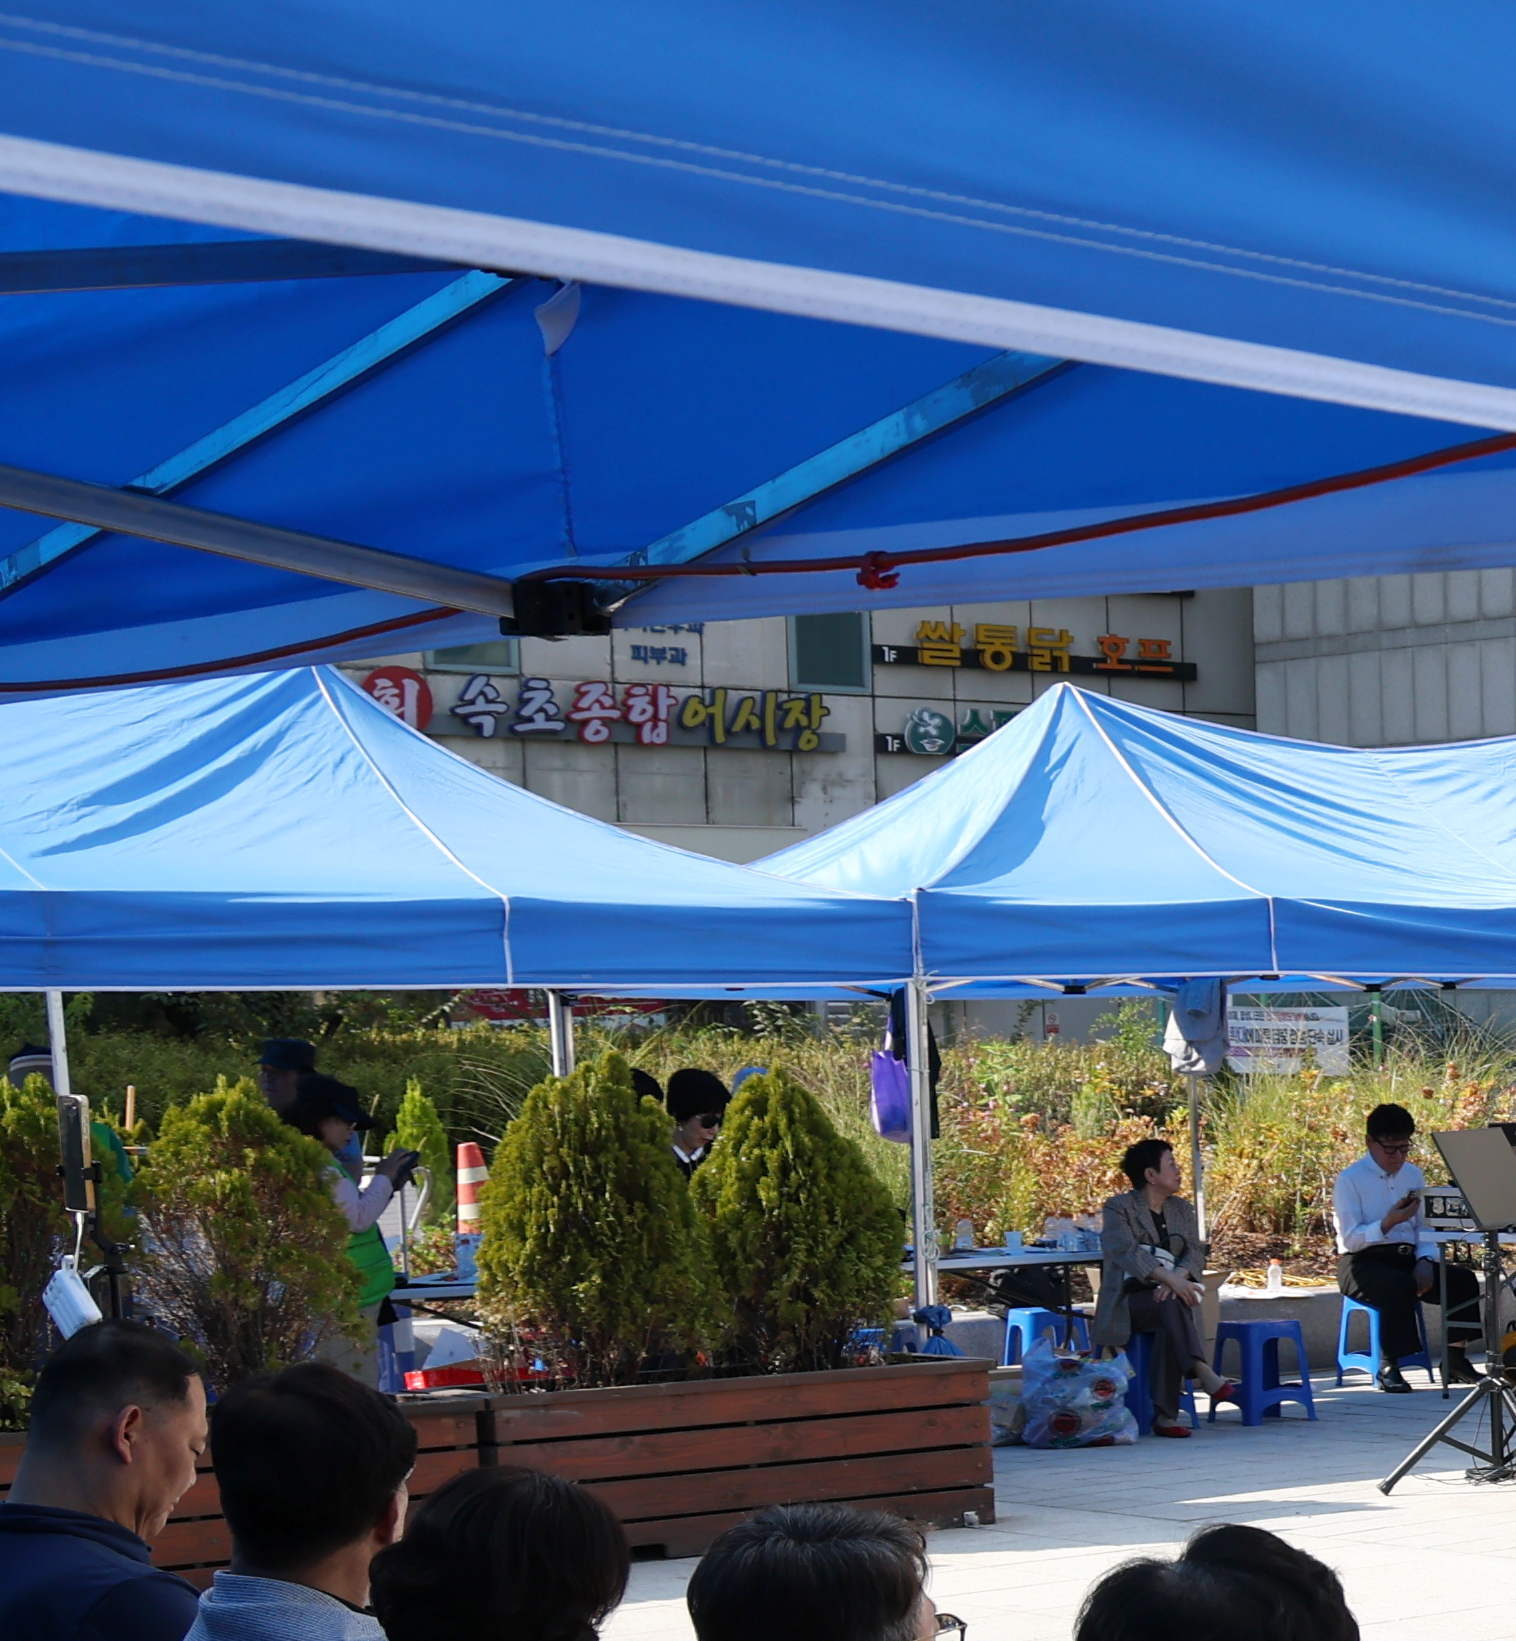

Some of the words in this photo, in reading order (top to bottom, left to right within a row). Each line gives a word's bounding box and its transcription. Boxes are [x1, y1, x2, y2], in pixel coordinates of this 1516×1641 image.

[630, 644, 688, 666] 피부과
[882, 646, 897, 662] 1F
[914, 620, 1075, 673] 쌀통닭
[1092, 633, 1174, 673] 호프
